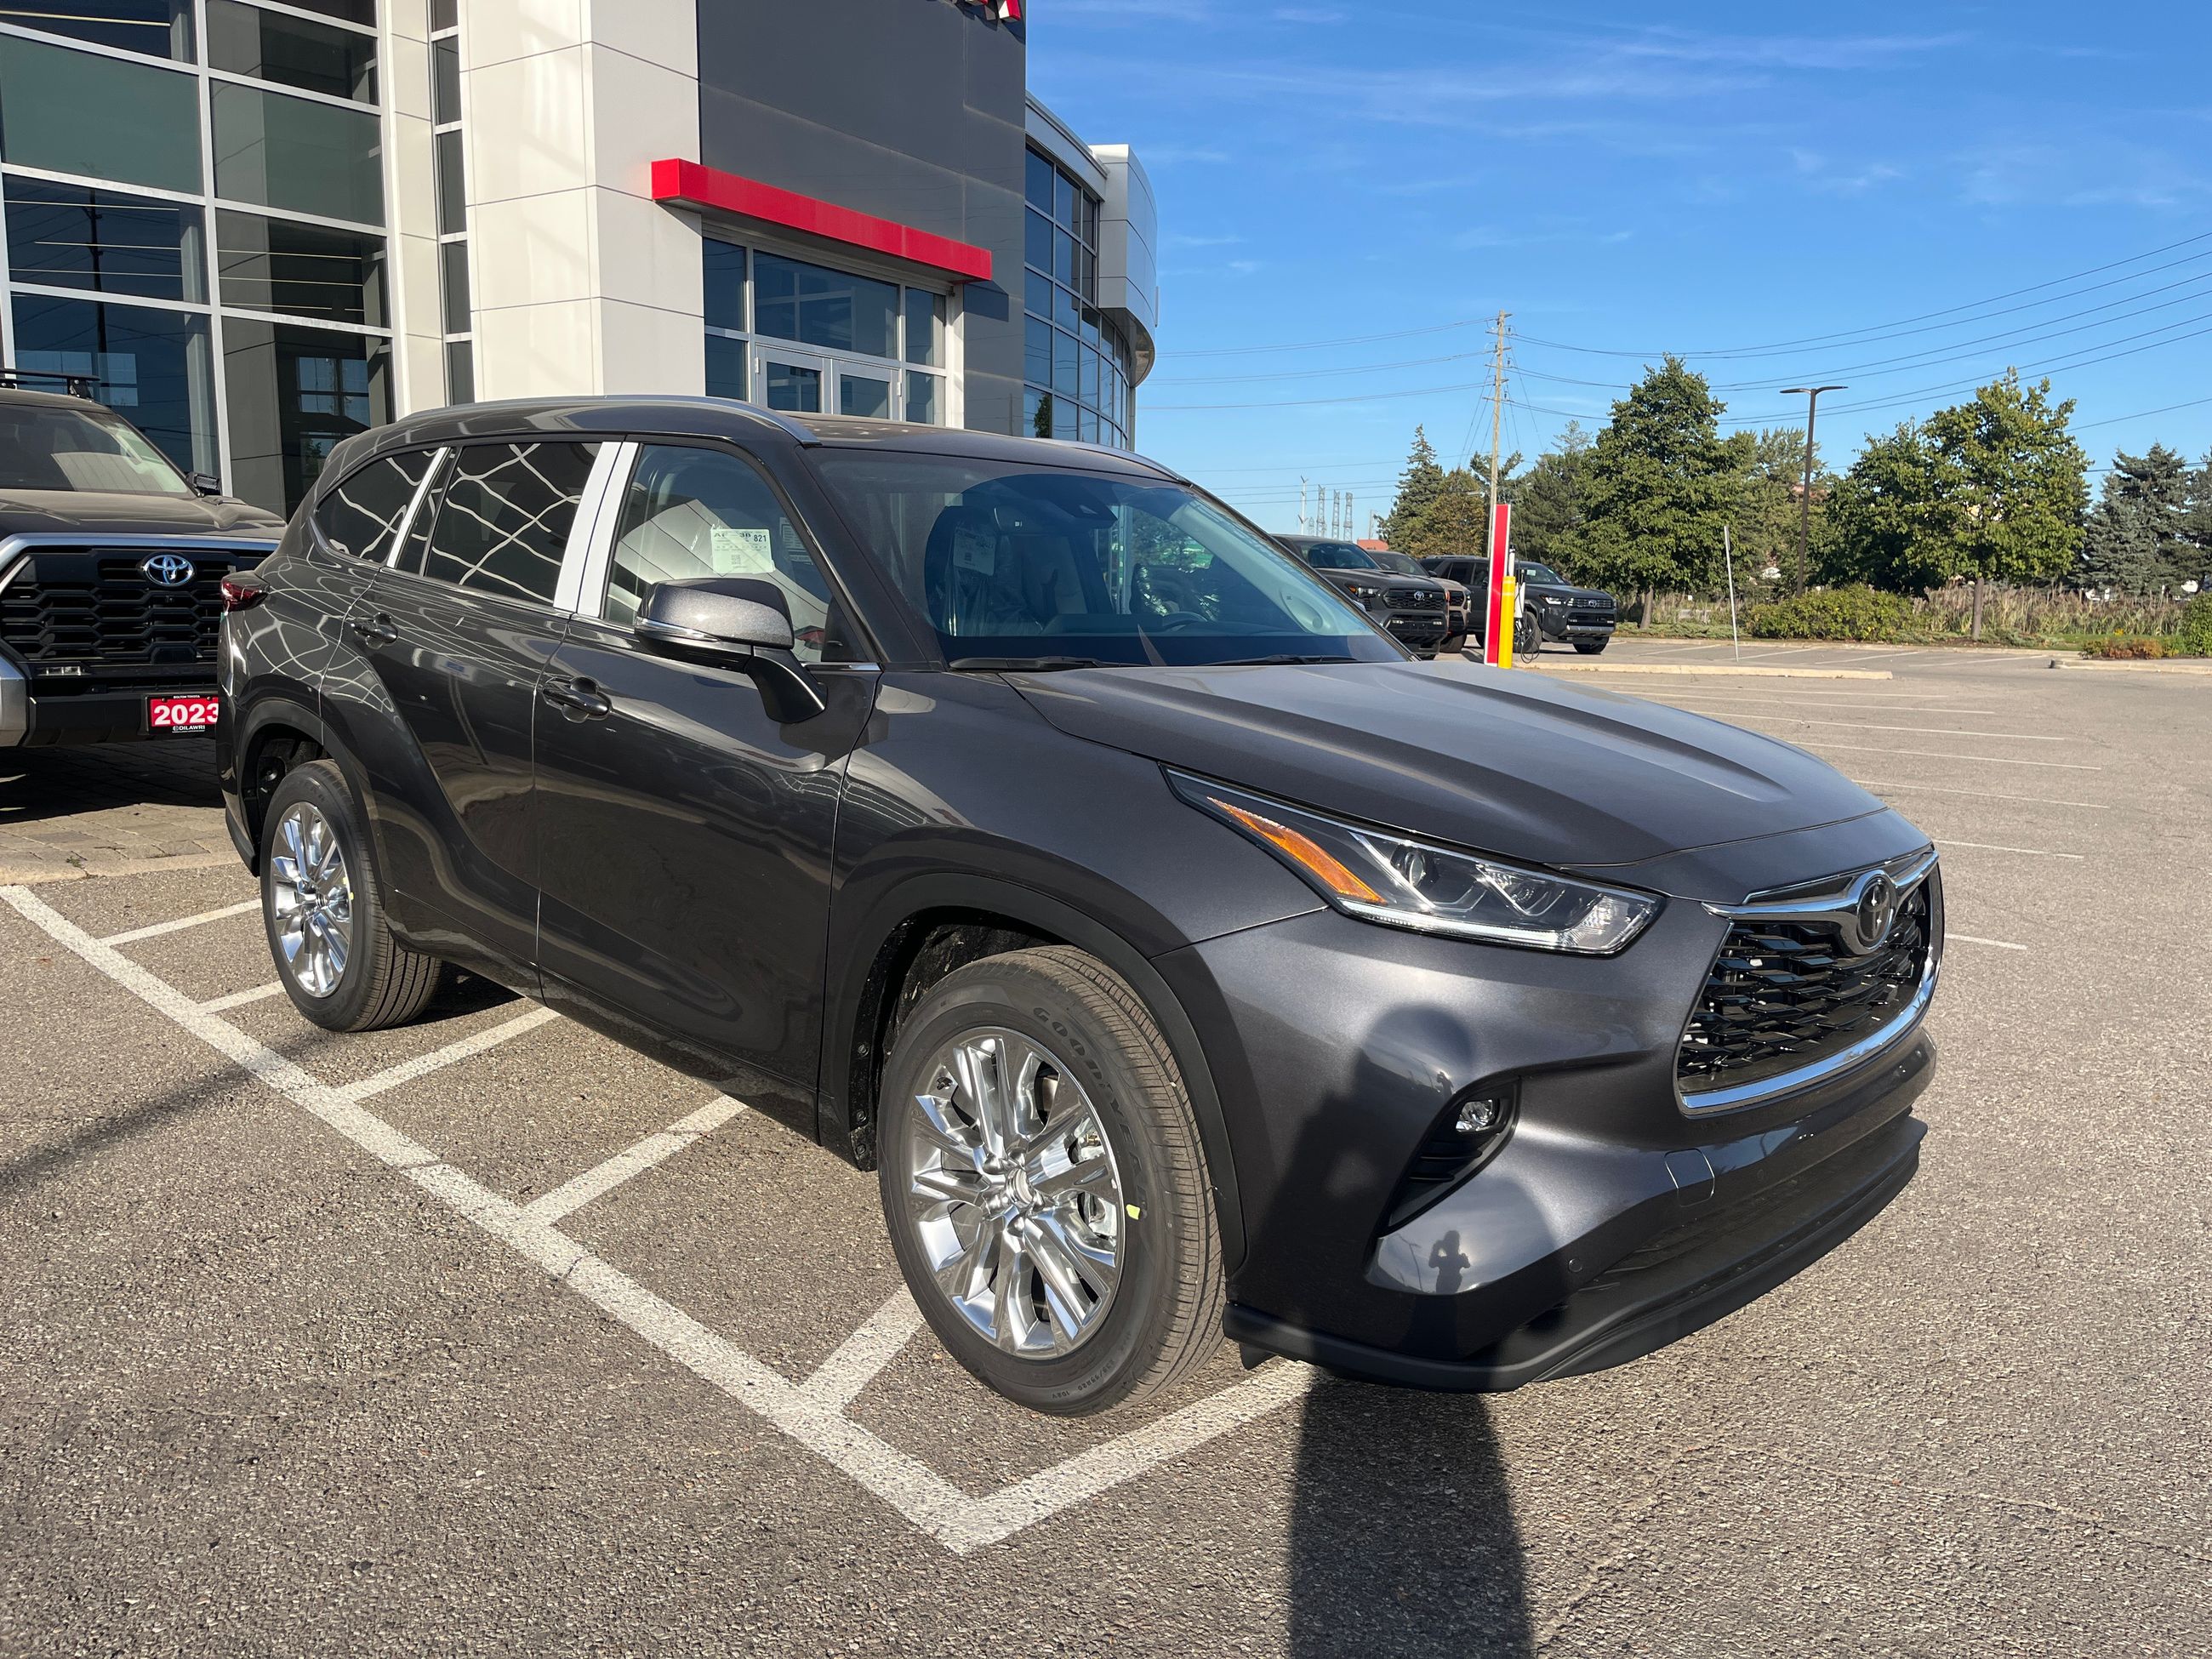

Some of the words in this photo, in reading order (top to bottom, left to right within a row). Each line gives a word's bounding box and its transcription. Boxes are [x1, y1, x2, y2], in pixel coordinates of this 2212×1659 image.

[754, 534, 767, 543] 821
[154, 704, 219, 725] 2023
[1033, 1006, 1148, 1211] GOODYEAR
